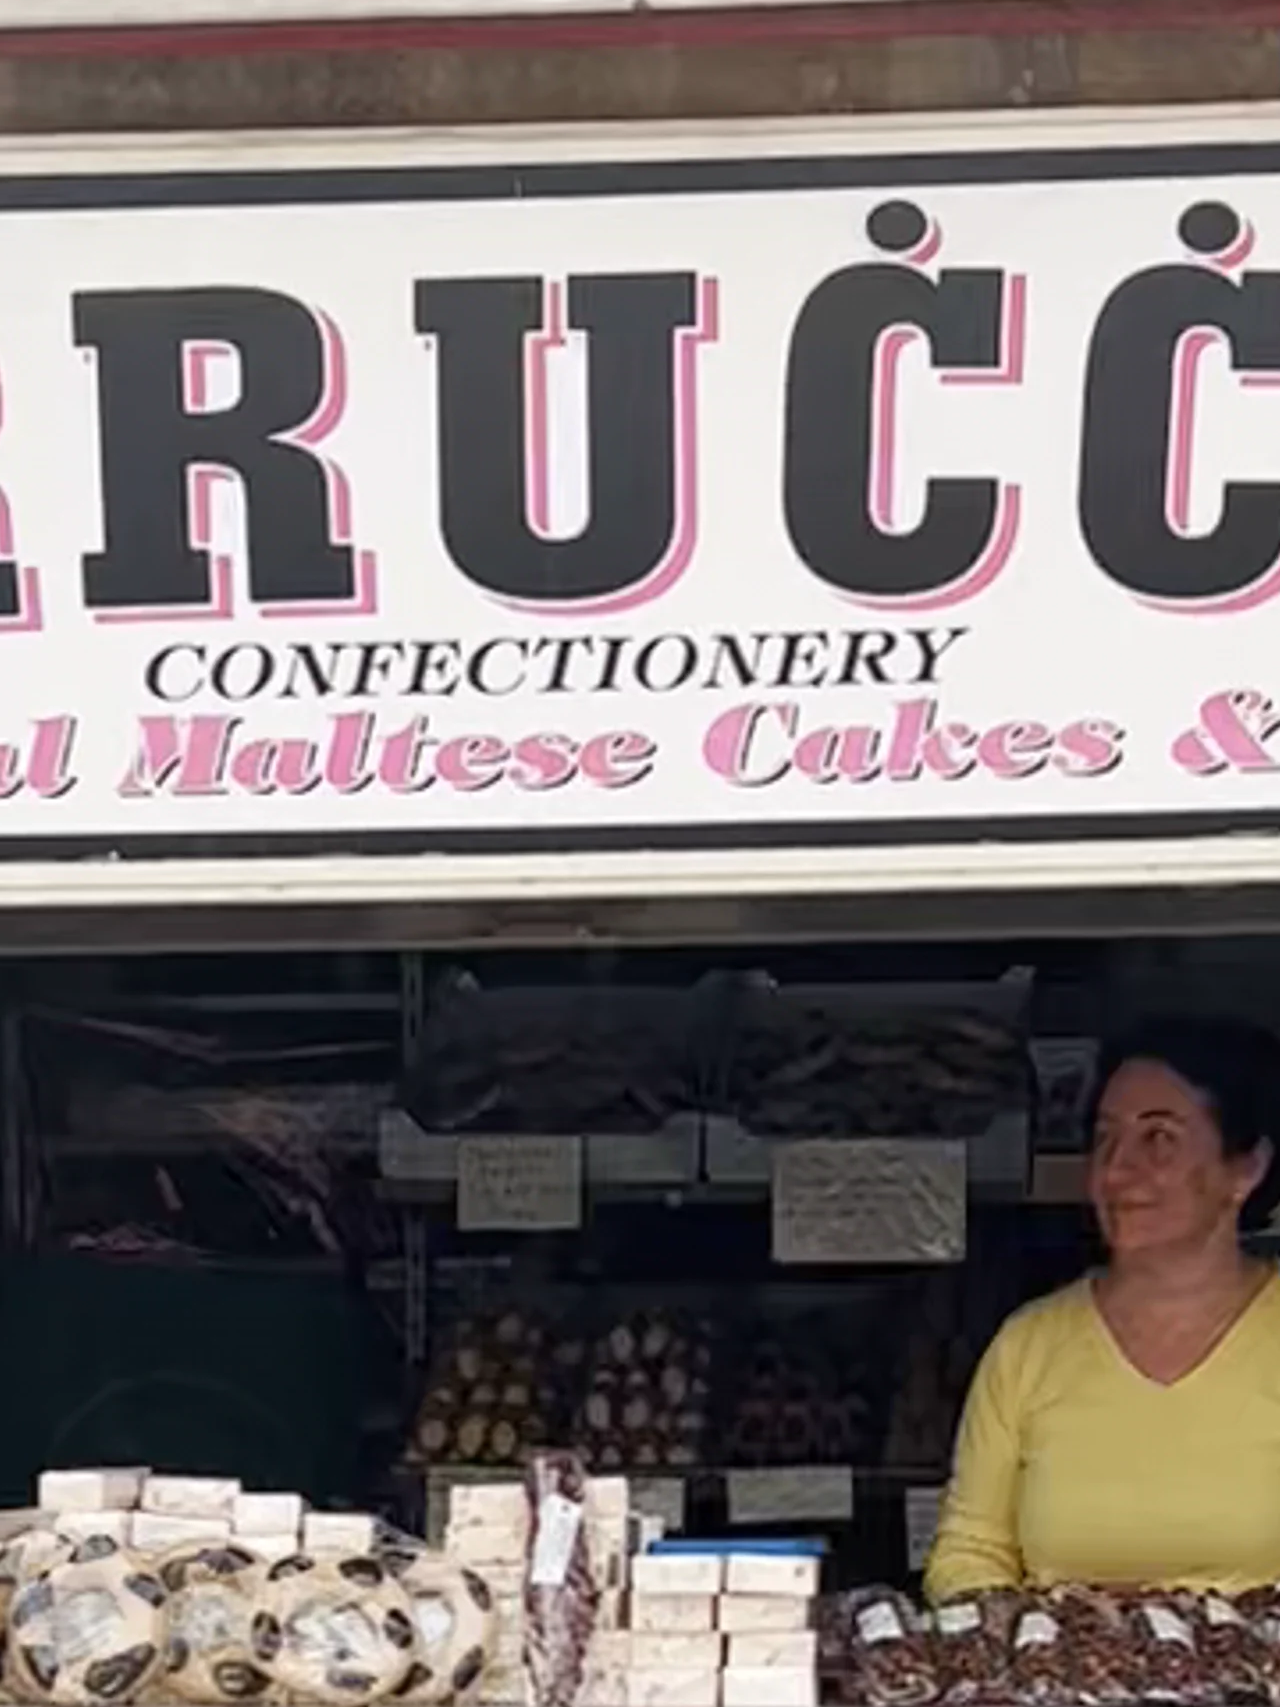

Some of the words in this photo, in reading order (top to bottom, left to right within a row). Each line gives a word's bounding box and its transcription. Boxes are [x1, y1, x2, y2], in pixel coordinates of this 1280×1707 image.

[144, 626, 969, 701] CONFECTIONERY
[116, 709, 658, 798] Maltese
[700, 697, 1127, 787] Cakes
